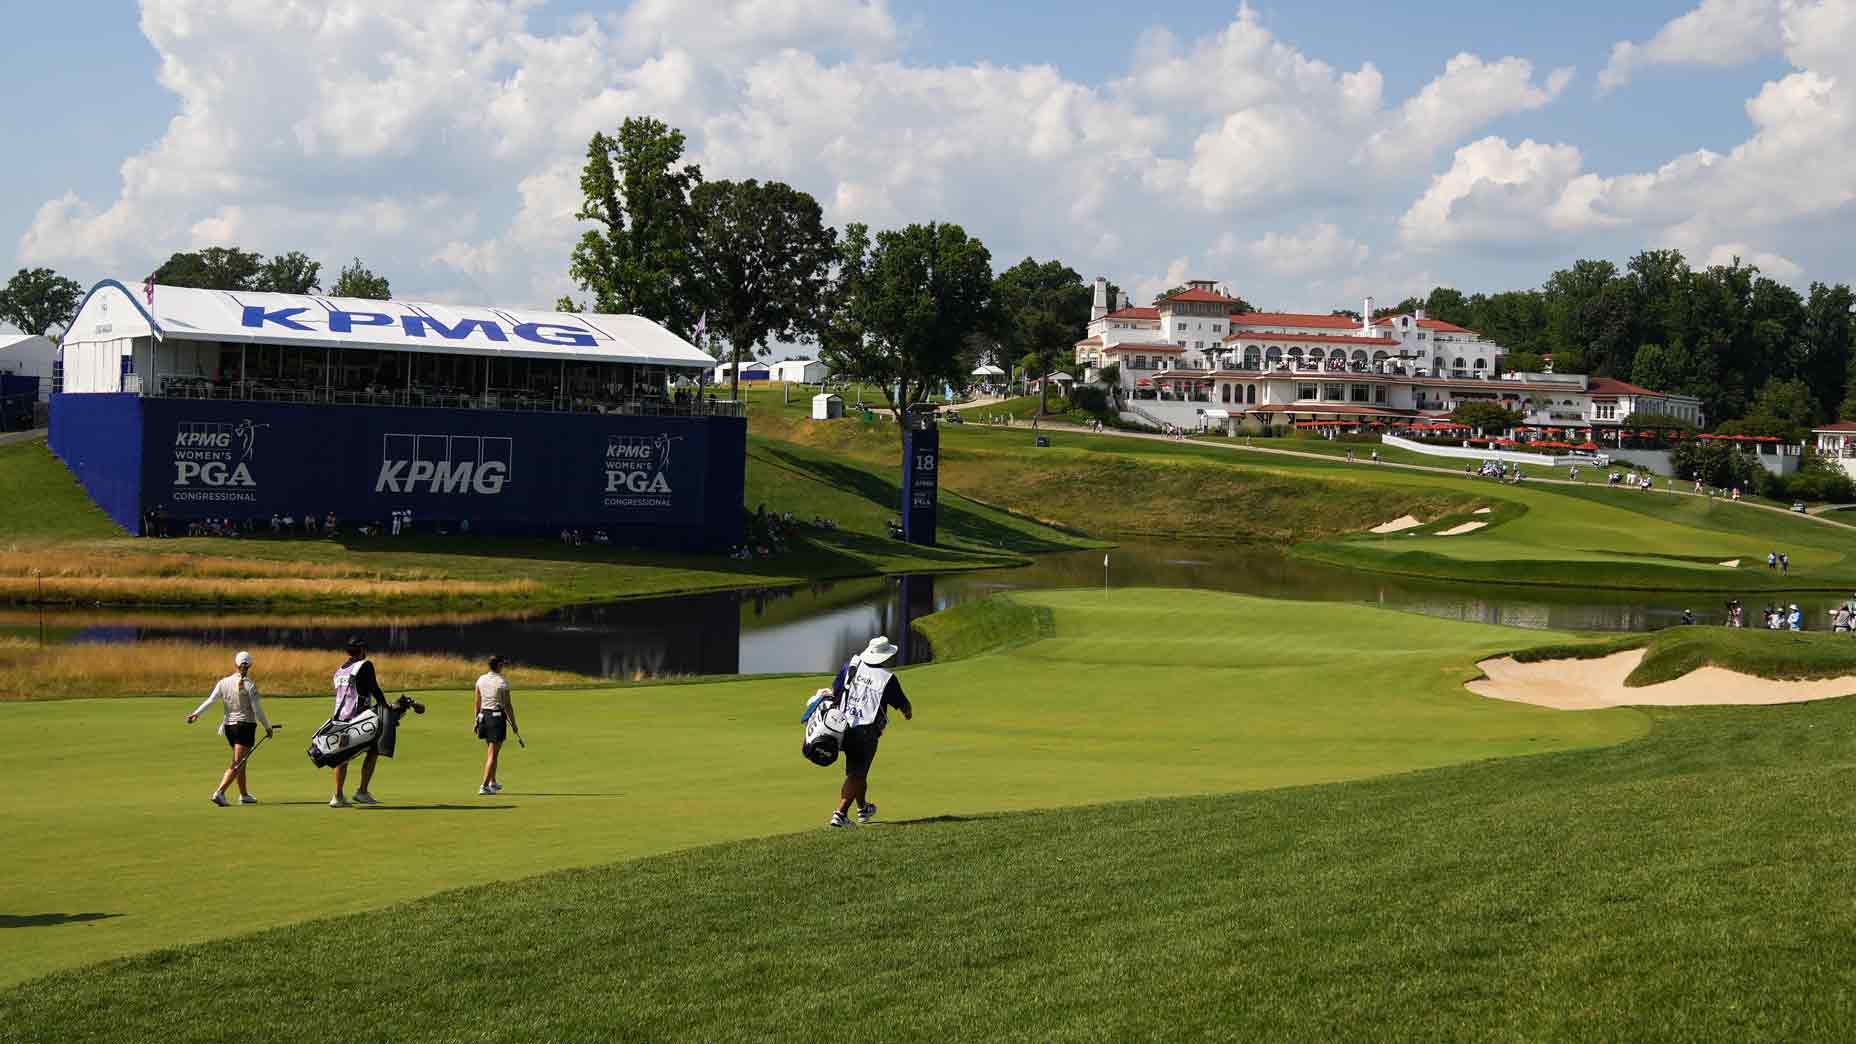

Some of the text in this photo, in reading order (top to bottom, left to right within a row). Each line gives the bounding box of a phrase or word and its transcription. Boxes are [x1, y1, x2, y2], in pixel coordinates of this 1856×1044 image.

[241, 305, 599, 347] KPMG
[175, 432, 231, 447] KPMG
[175, 451, 232, 460] WOMEN'S
[606, 445, 651, 458] KPMG
[916, 455, 935, 470] 18
[173, 461, 257, 486] PGA
[375, 460, 507, 494] KPMG
[605, 470, 672, 492] PGA
[174, 492, 257, 501] CONGRESSIONAL
